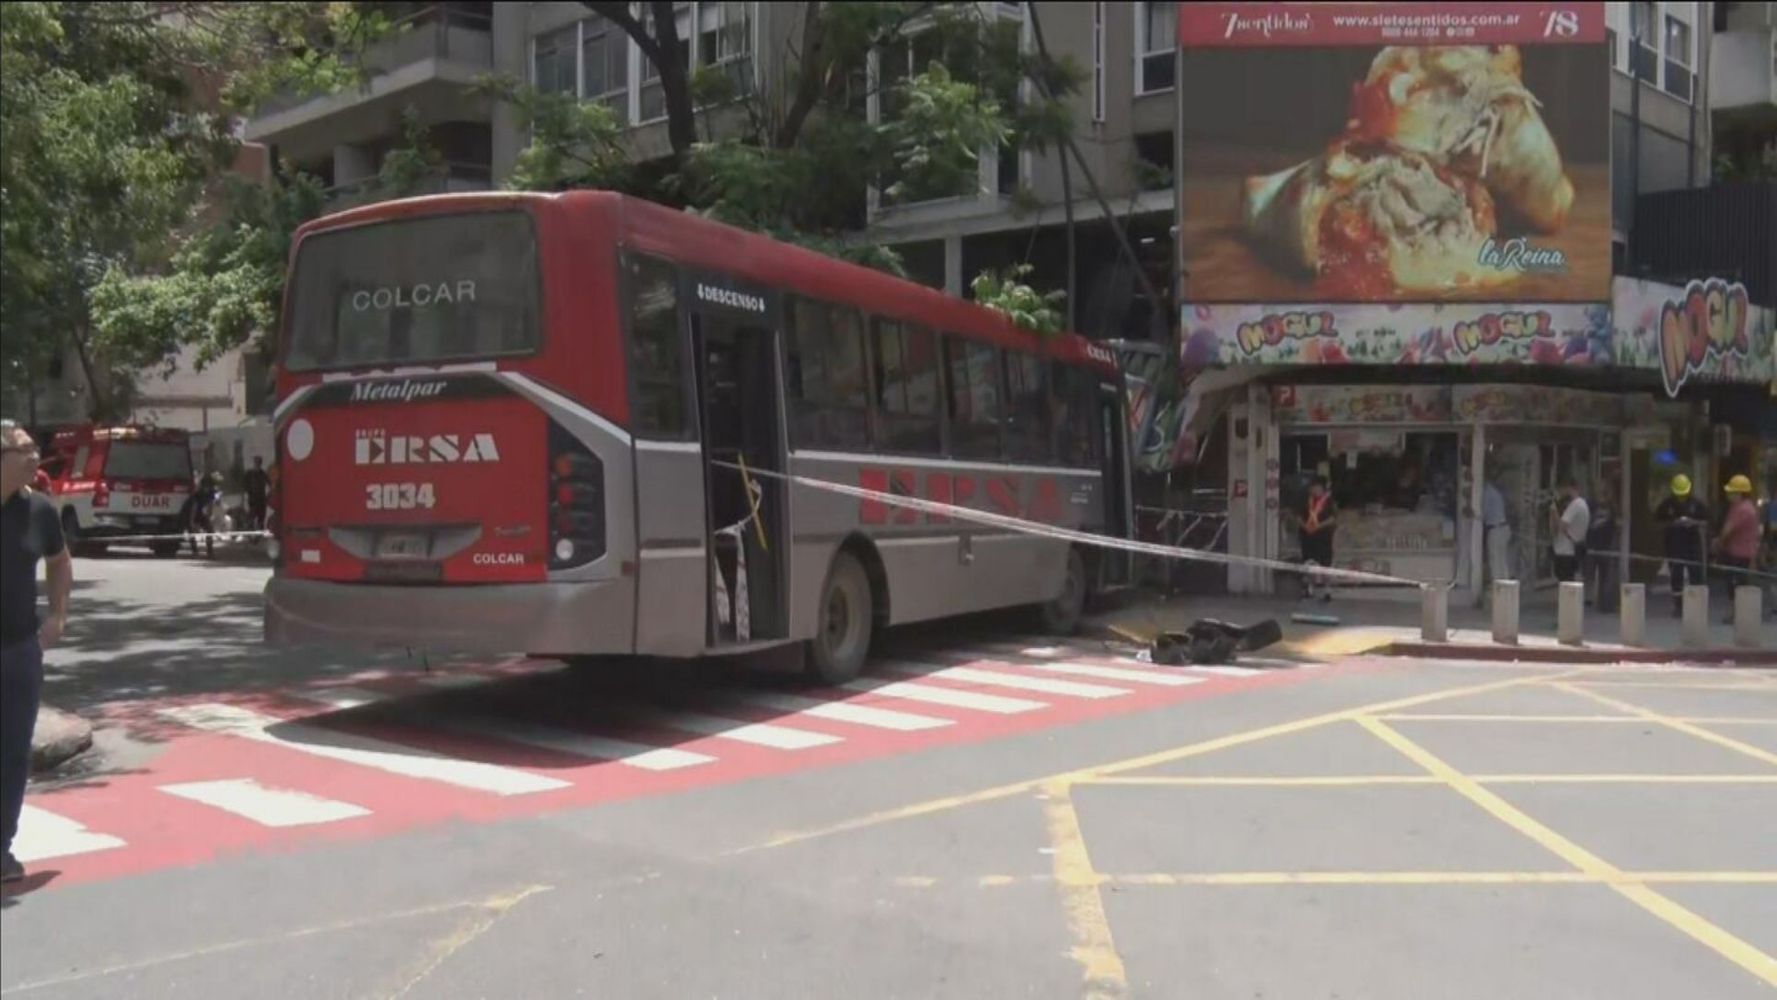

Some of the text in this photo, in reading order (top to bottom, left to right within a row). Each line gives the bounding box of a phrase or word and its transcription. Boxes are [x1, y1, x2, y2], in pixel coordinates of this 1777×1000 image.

[1333, 13, 1521, 27] www.sietesentidos.com.ar
[353, 280, 477, 312] COLCAR
[704, 286, 759, 311] DESCENSO
[1237, 311, 1339, 356] MOGUL
[1453, 310, 1556, 356] MOGUL
[350, 379, 448, 402] Metalpar
[355, 432, 500, 465] ERSA
[131, 496, 171, 508] DUAR
[366, 482, 436, 510] 3034
[858, 469, 1064, 526] ERSA
[473, 553, 524, 565] COLCAR
